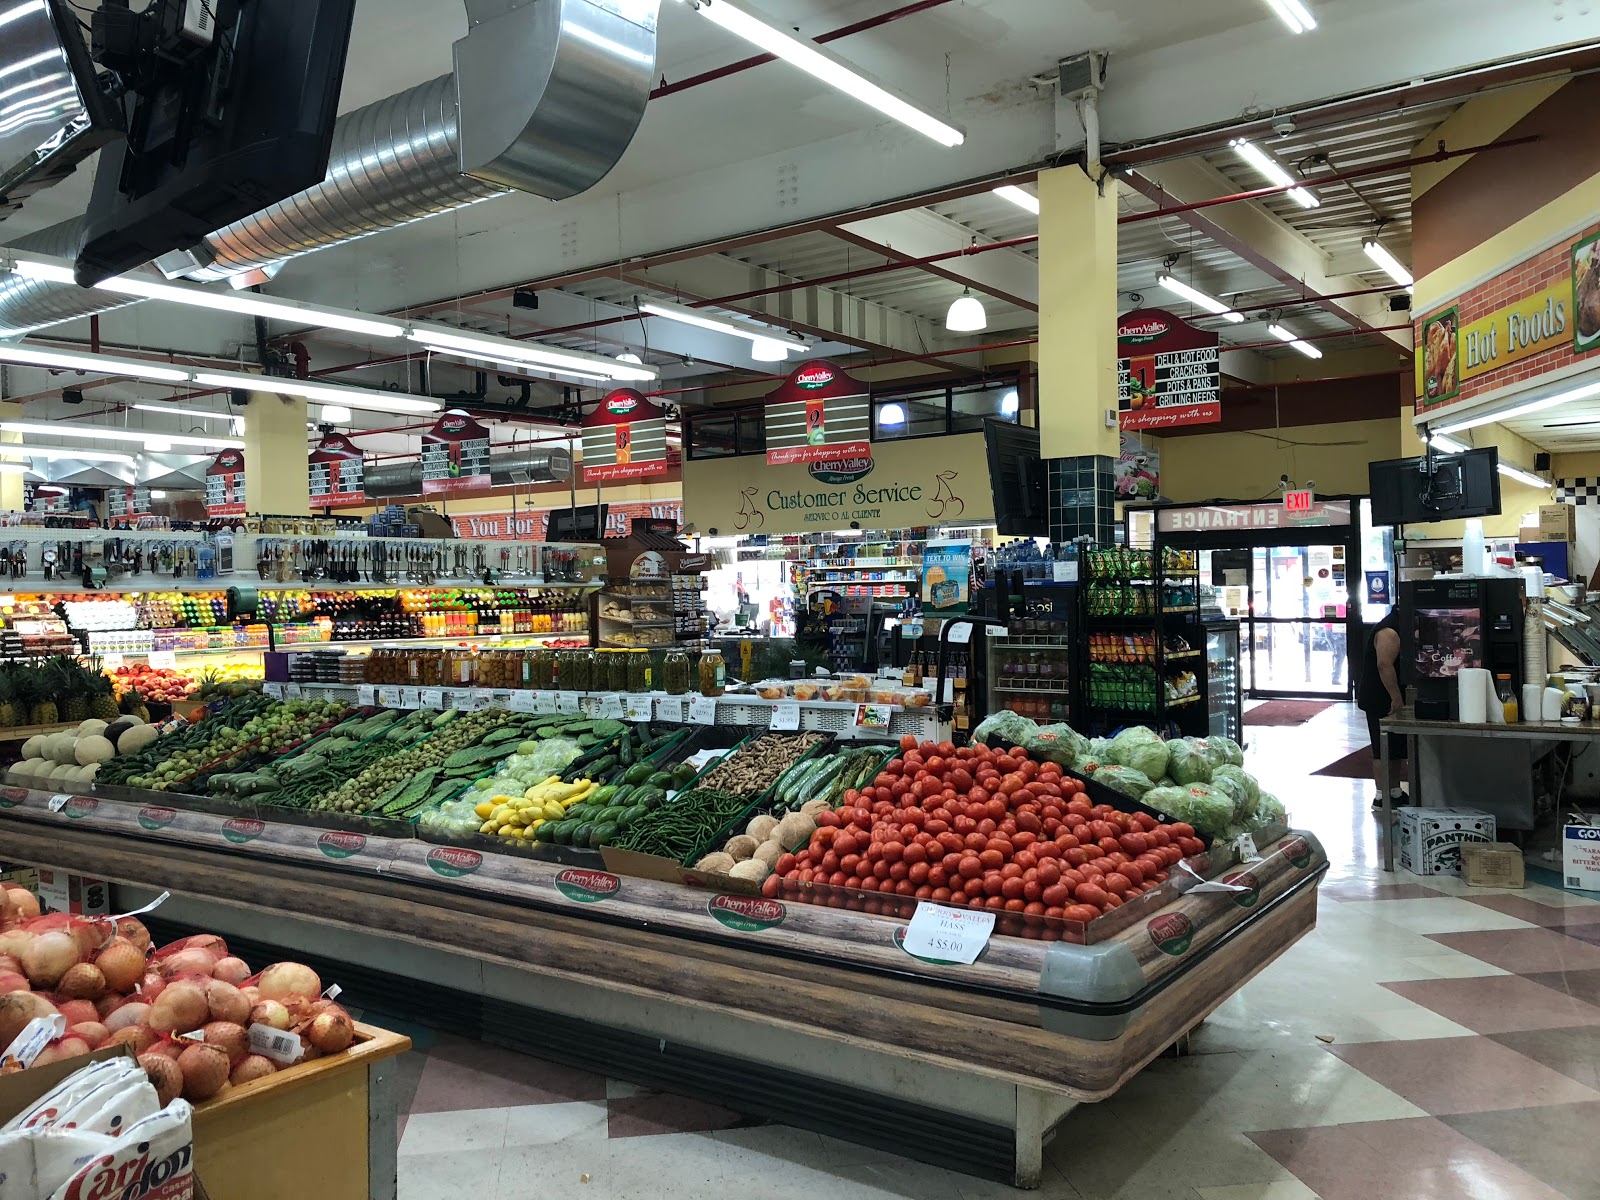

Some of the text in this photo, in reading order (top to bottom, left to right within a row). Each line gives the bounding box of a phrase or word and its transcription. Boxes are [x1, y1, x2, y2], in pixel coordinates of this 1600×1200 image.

[1466, 297, 1566, 369] Hot Foods
[1157, 348, 1217, 366] DELI & HOT FOOD
[1169, 363, 1208, 379] CRACKERS
[1166, 377, 1212, 393] POTS & PANS
[1158, 390, 1216, 407] GRILLING NEEDS
[810, 409, 820, 429] 2
[1122, 416, 1136, 428] for
[1138, 413, 1177, 426] shopping
[1180, 408, 1200, 419] with
[619, 431, 627, 449] 3
[770, 452, 789, 461] Thank
[790, 453, 802, 463] you
[802, 450, 812, 460] for
[813, 448, 841, 458] shopping
[842, 445, 857, 454] with
[587, 469, 602, 477] Thank
[602, 471, 612, 479] you
[612, 468, 620, 477] for
[620, 467, 642, 475] shopping
[644, 464, 656, 472] with
[767, 483, 922, 511] Customer Service
[1286, 492, 1310, 509] EXIT
[468, 518, 499, 538] You
[505, 516, 534, 536] For
[651, 503, 684, 527] Wit
[841, 510, 850, 520] AL
[851, 509, 881, 520] CLIENTE
[1431, 653, 1462, 662] Coffee
[940, 920, 966, 931] HASS
[935, 938, 963, 952] $5.00
[161, 1175, 193, 1195] Cassa
